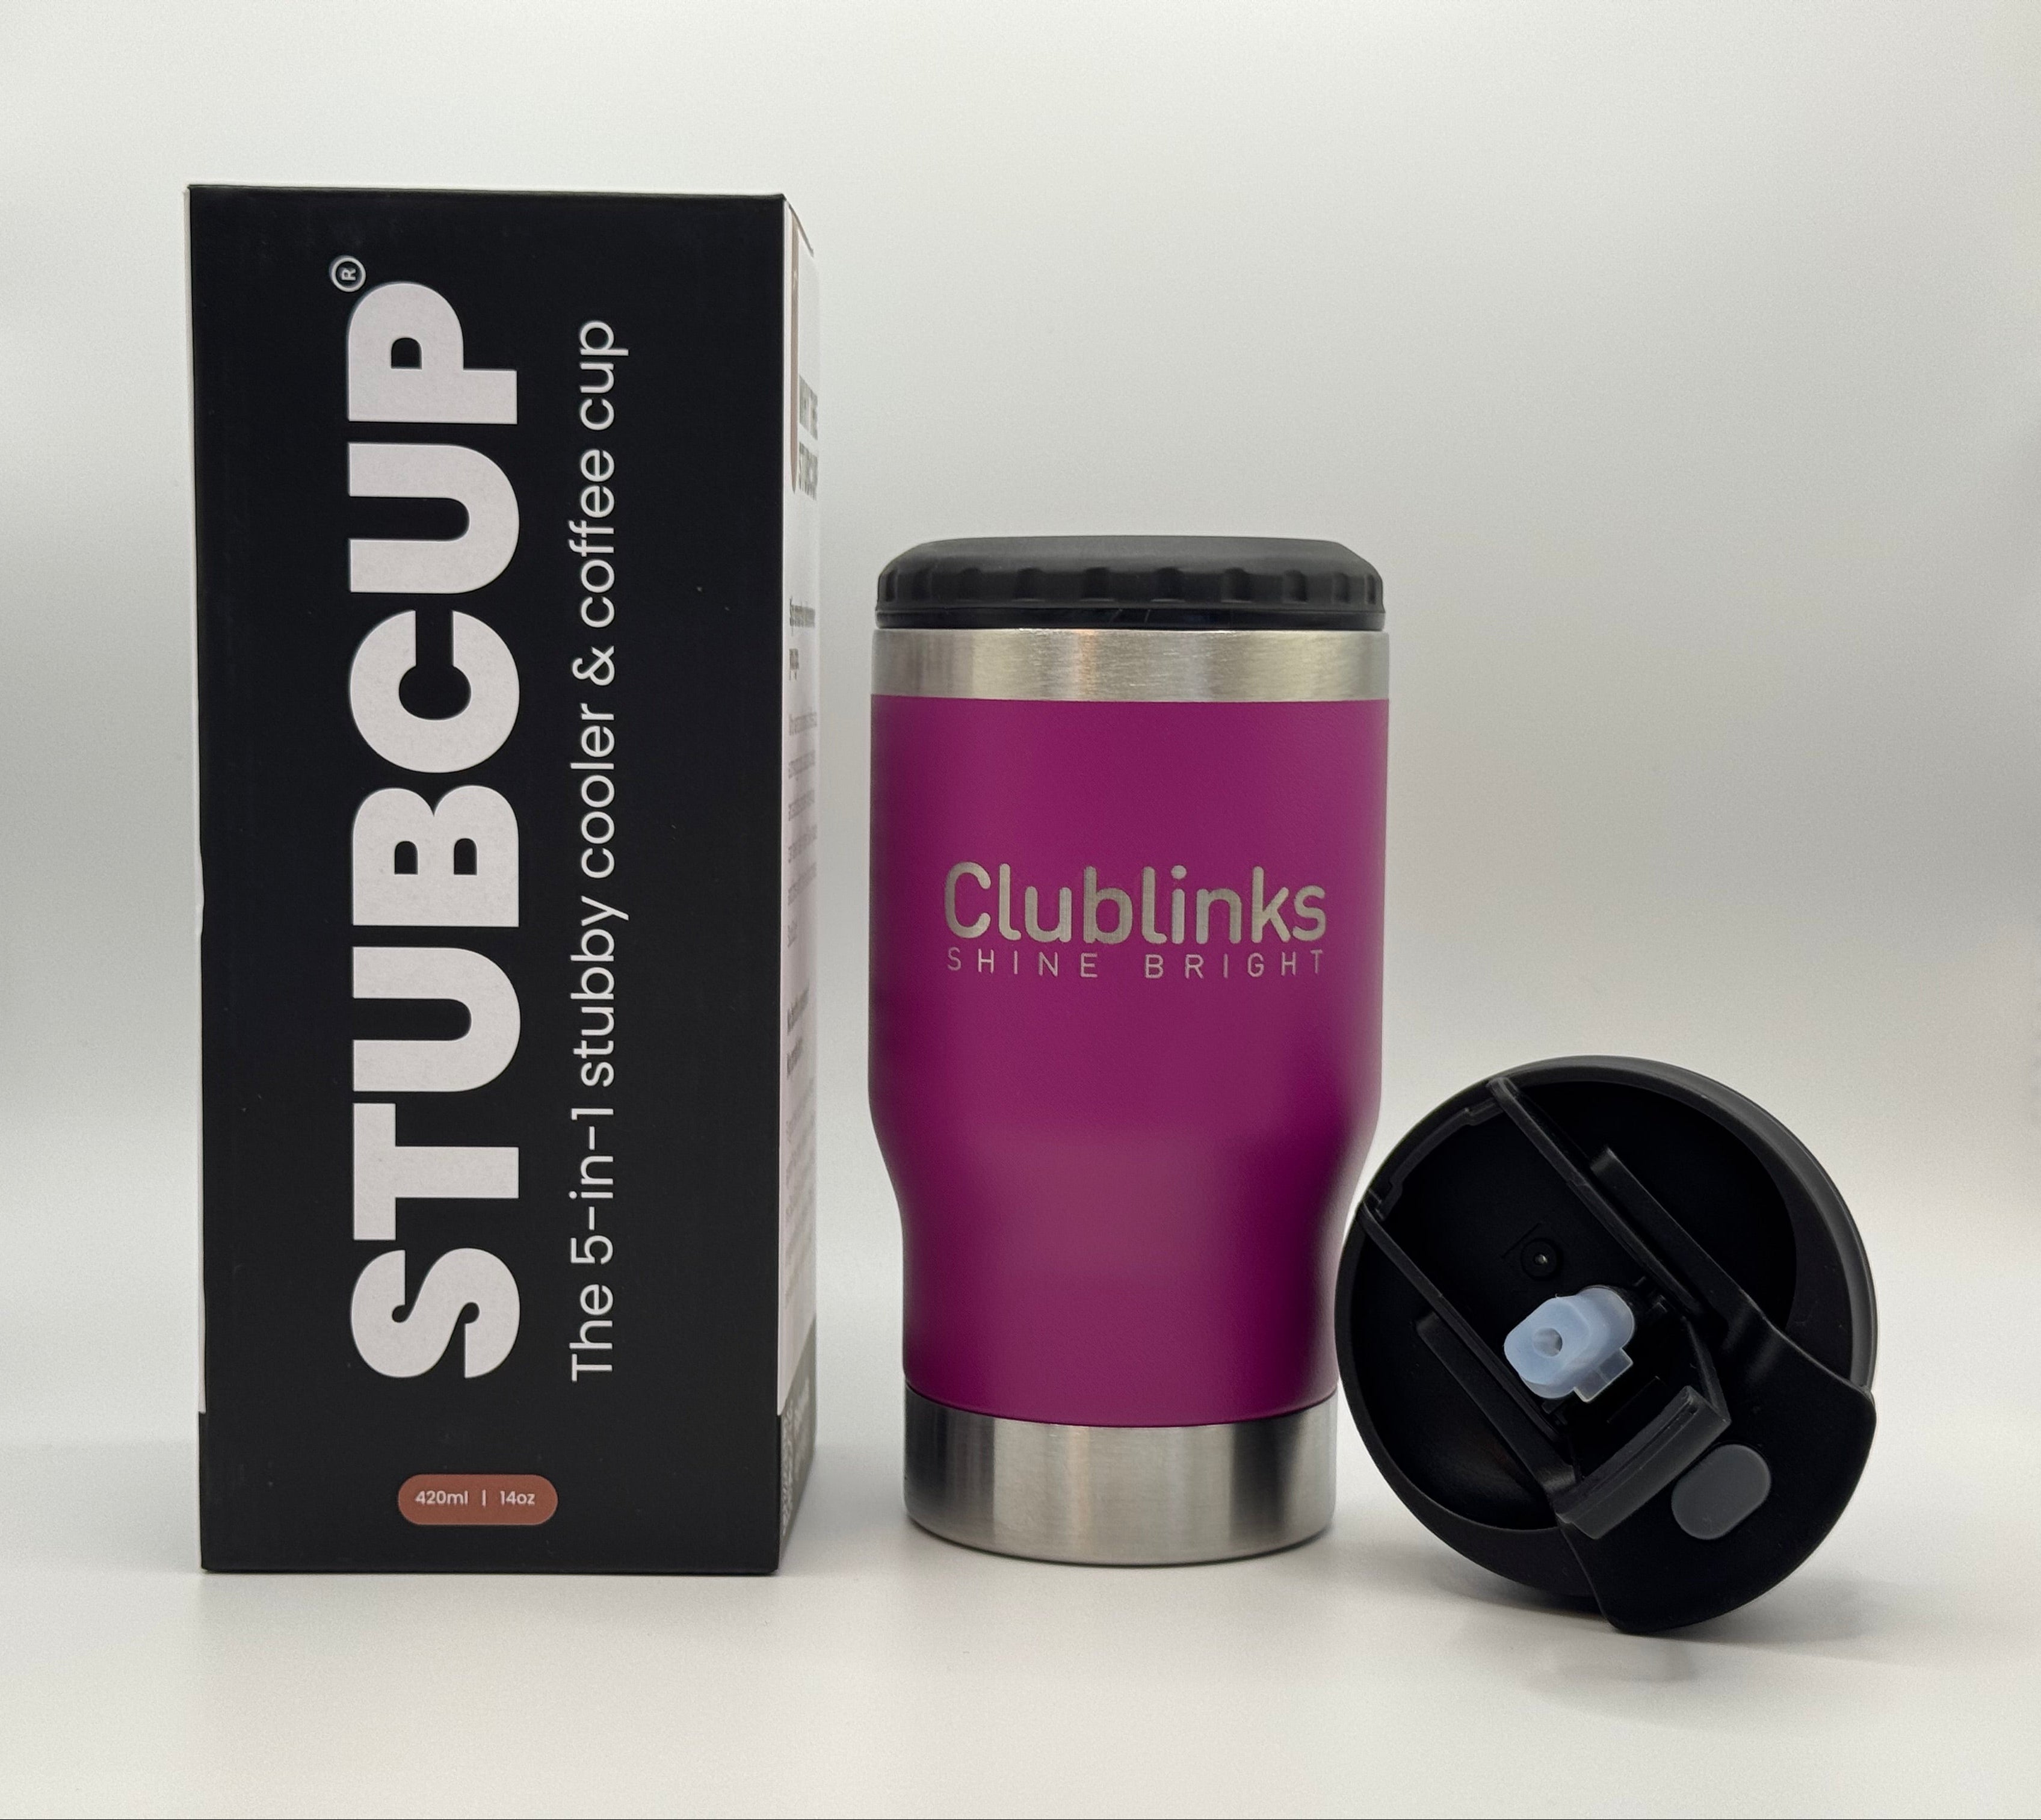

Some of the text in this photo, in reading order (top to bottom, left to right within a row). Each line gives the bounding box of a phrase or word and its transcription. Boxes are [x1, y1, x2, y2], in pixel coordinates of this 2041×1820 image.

[347, 282, 521, 1378] STUBCUP
[568, 320, 629, 1382] The 5-in-1 stubby cooler & coffee cup
[944, 861, 1327, 945] Clublinks
[946, 946, 1324, 979] SHINE BRIGHT
[415, 1490, 468, 1505] 420ml
[500, 1490, 536, 1505] 14oz
